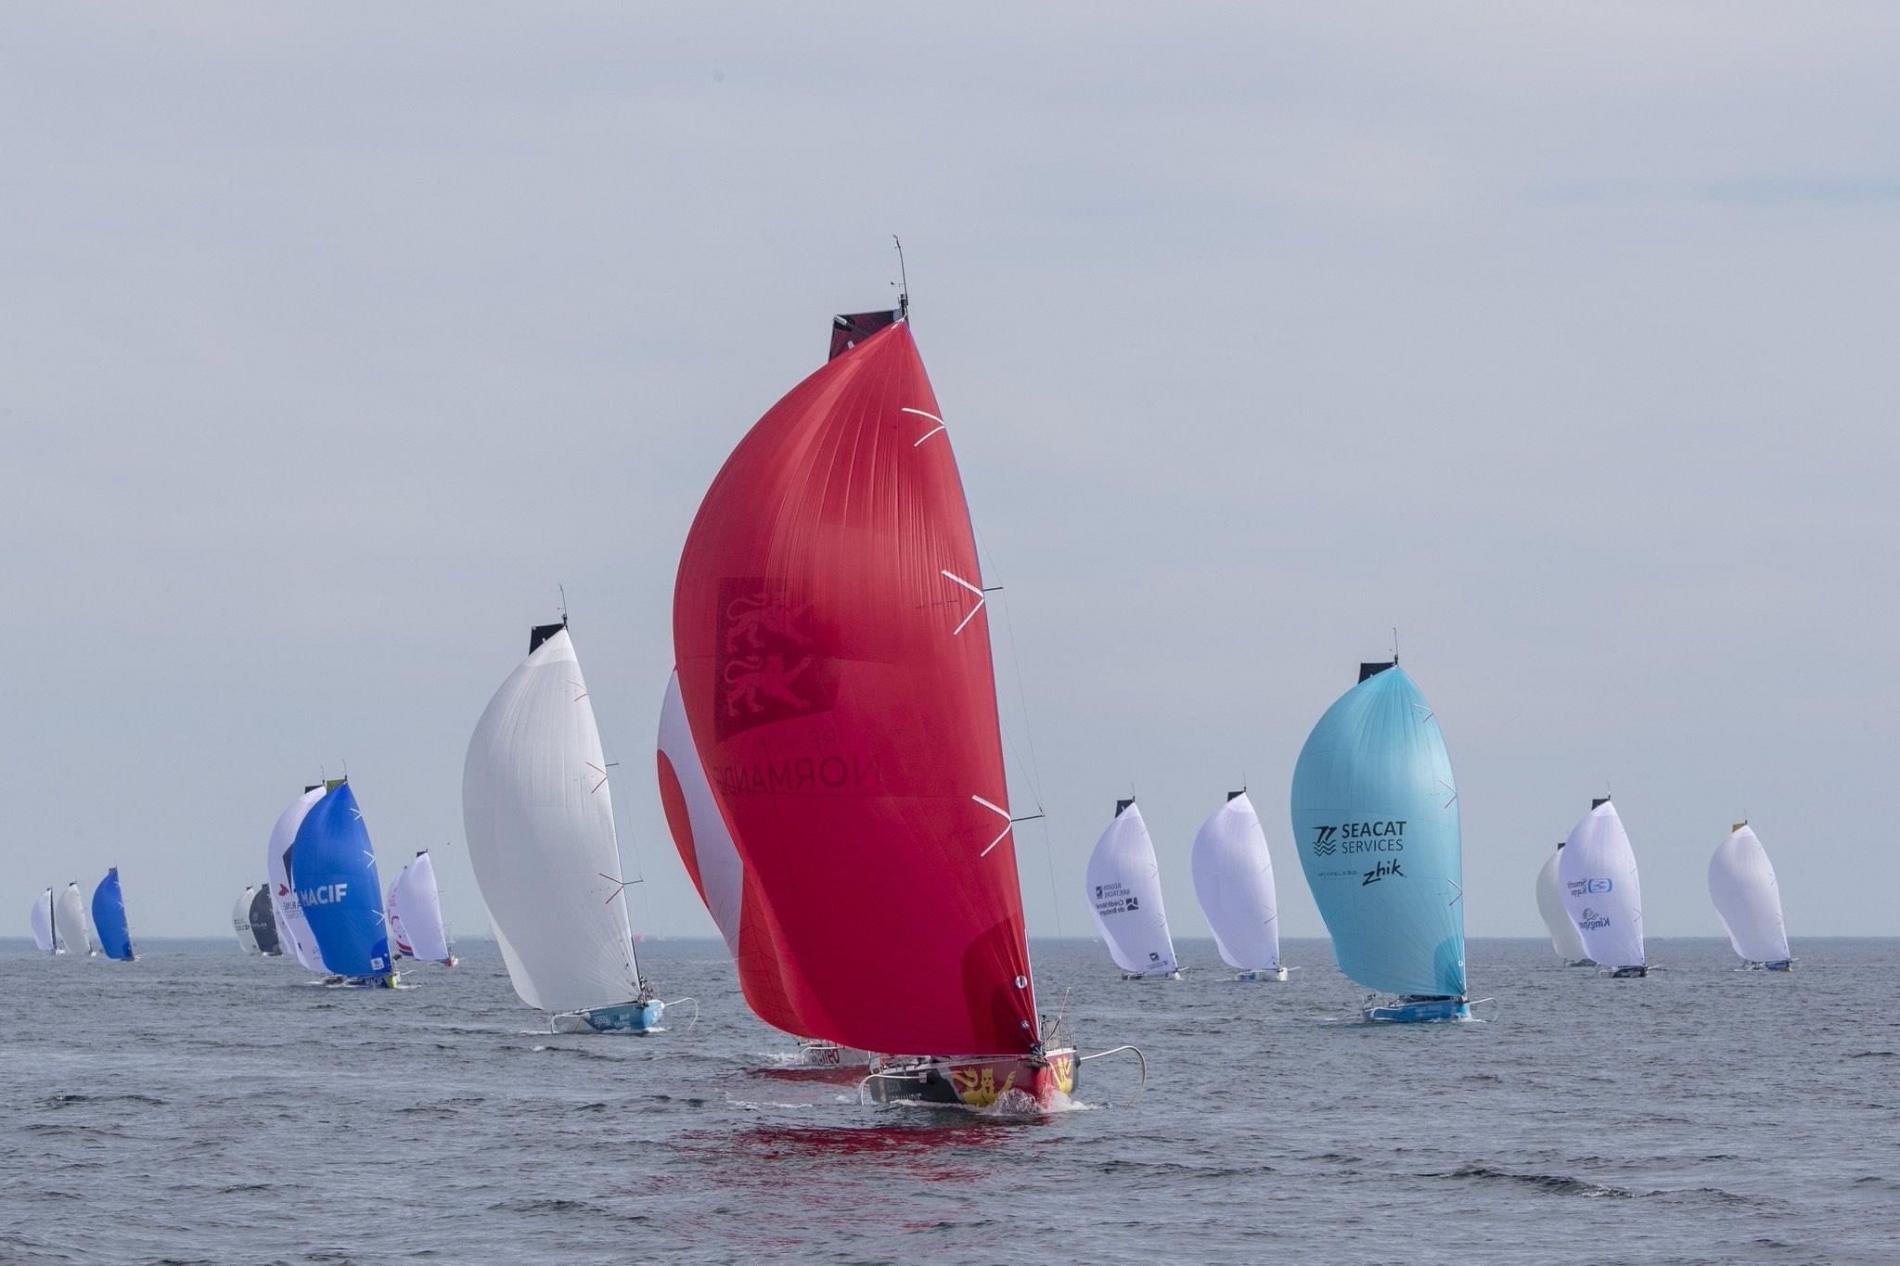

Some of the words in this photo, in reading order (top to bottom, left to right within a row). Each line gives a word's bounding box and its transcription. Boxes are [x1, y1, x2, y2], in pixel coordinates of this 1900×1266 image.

[1342, 821, 1407, 838] SEACAT
[1341, 838, 1404, 854] SERVICES
[1362, 858, 1405, 886] zhik
[300, 882, 348, 907] MACIF
